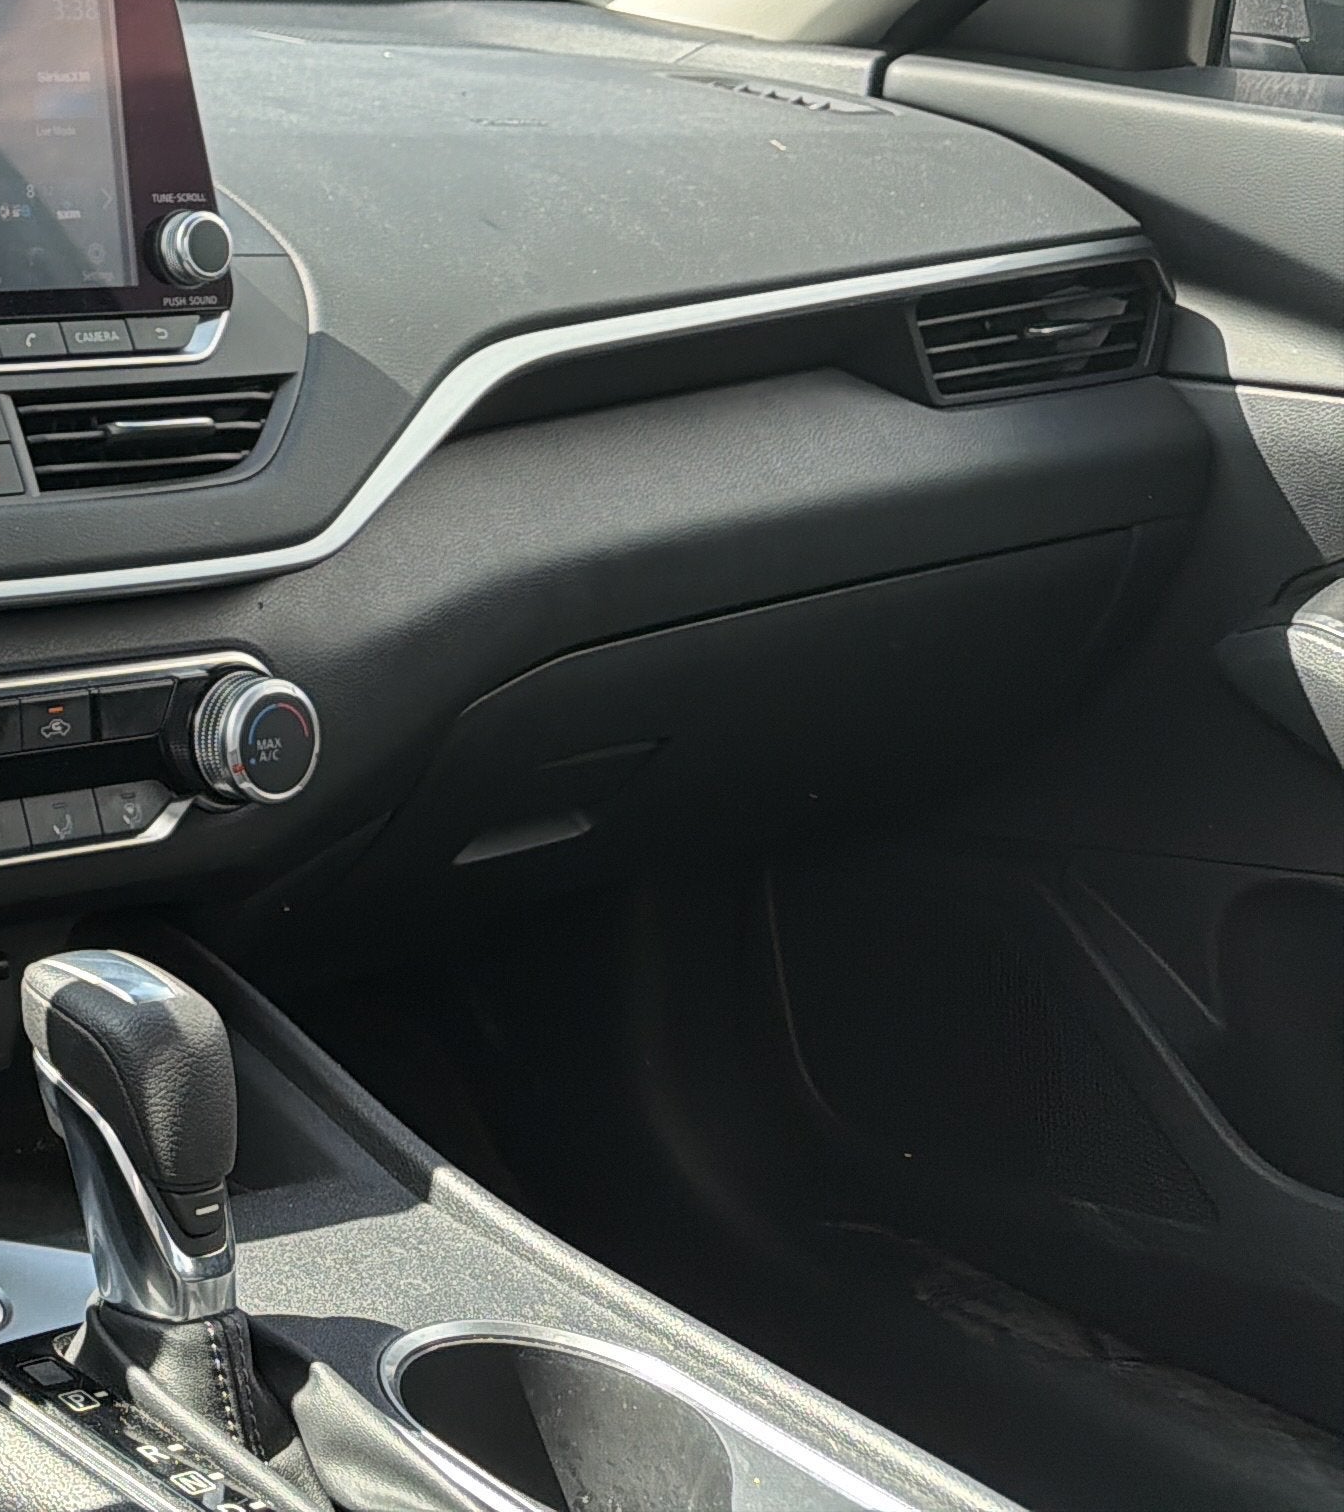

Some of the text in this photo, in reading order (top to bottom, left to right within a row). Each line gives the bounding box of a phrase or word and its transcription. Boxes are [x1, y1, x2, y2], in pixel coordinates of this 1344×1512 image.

[26, 184, 36, 198] 8
[189, 295, 218, 306] SOUND
[74, 330, 120, 344] CAMERA
[256, 737, 282, 751] MAX
[259, 749, 280, 762] A/C
[70, 1393, 86, 1408] P
[136, 1444, 170, 1463] R
[181, 1474, 206, 1492] N
